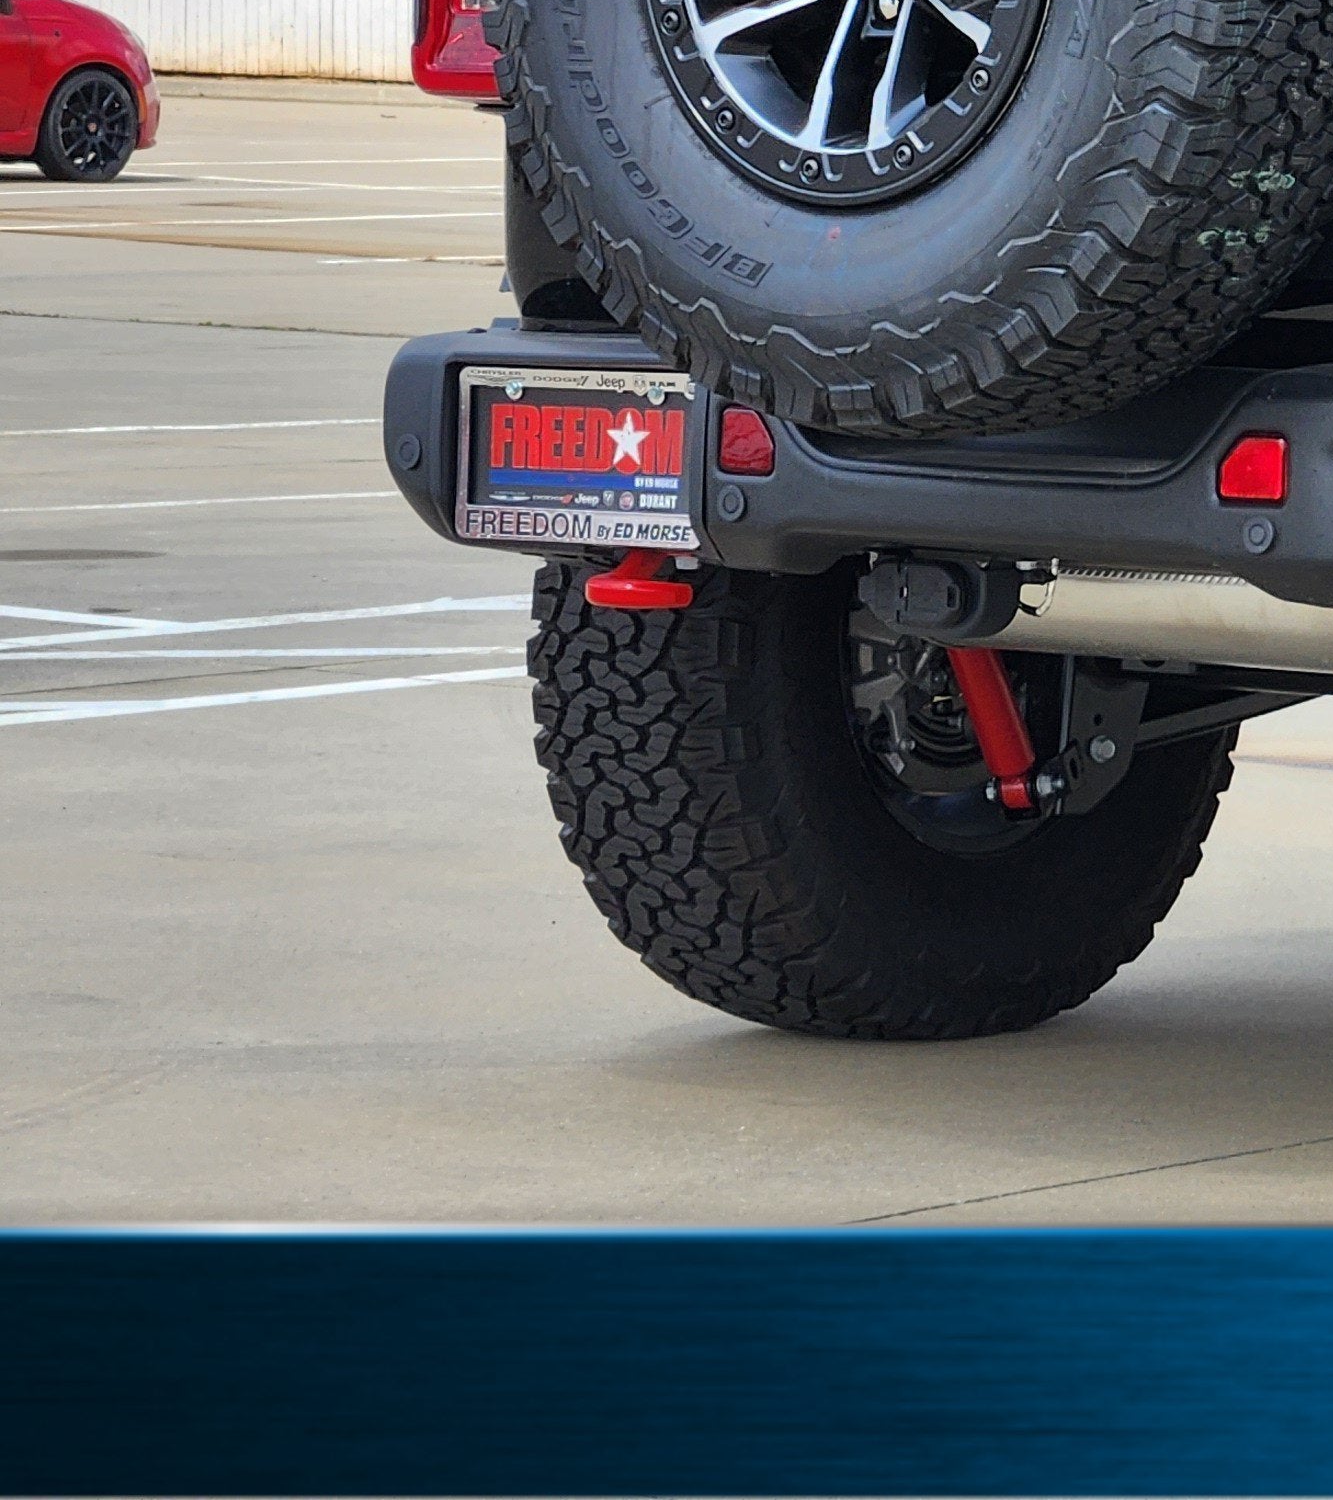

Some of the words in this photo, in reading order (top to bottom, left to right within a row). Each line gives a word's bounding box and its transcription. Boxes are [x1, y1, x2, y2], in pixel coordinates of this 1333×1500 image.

[532, 375, 580, 384] DODGE
[596, 374, 626, 390] Jeep
[490, 403, 685, 475] FREEDOM
[574, 493, 599, 506] Jeep
[639, 494, 678, 509] DURANT
[465, 509, 593, 539] FREEDOM
[613, 523, 633, 538] ED
[635, 524, 692, 542] MORSE
